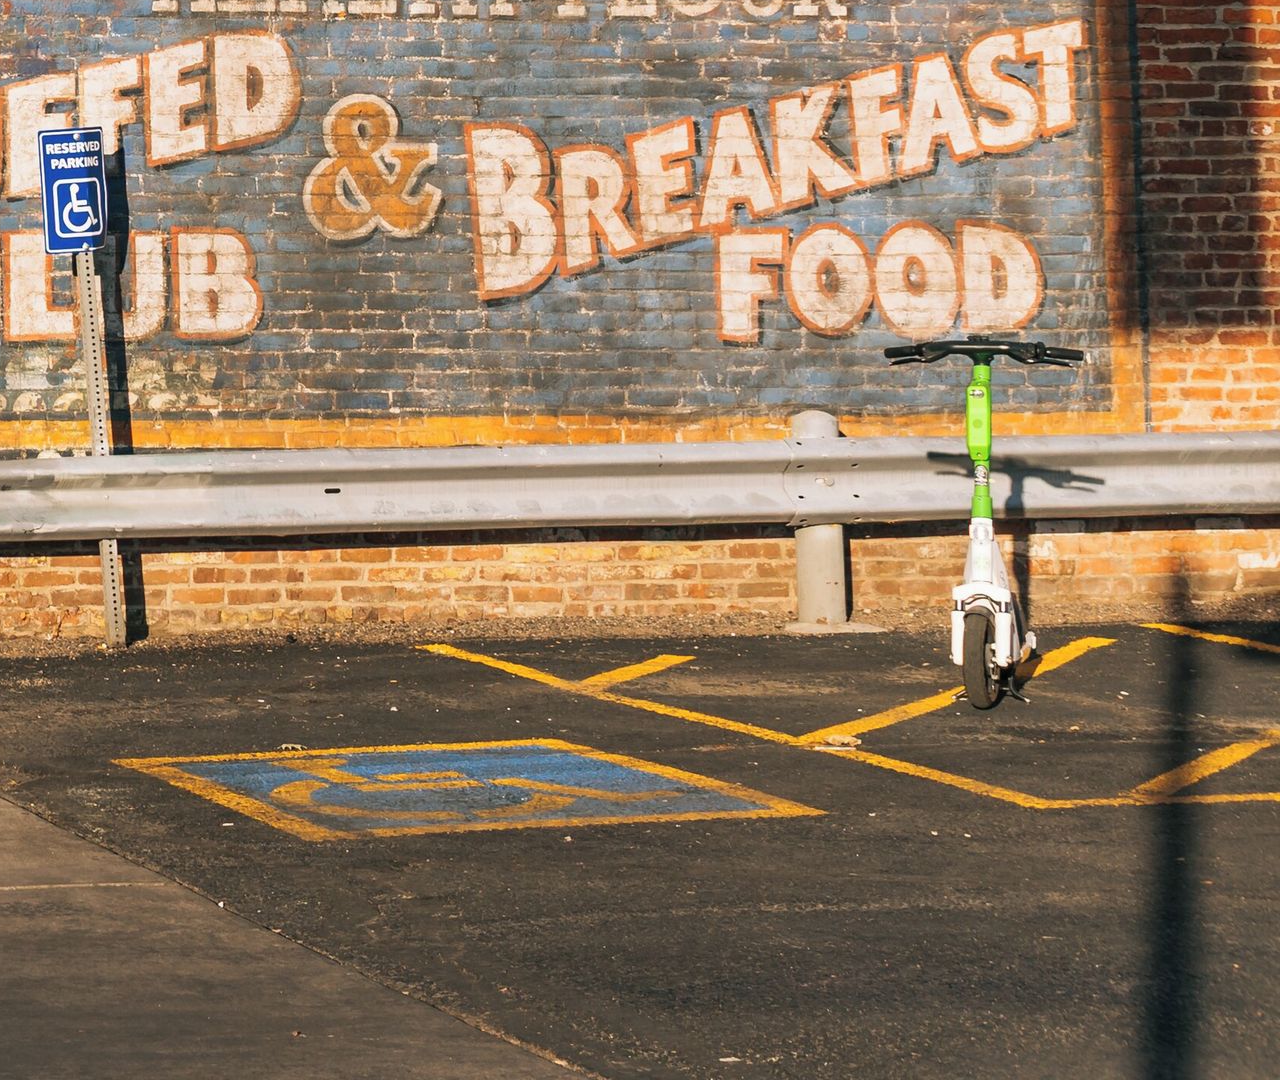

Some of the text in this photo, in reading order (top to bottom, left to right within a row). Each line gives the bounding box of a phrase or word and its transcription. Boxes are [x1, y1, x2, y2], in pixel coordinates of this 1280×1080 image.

[45, 141, 100, 155] RESERVED
[50, 156, 99, 170] PARKING
[303, 93, 443, 241] &
[464, 18, 1089, 302] BREAKFAST
[713, 219, 1048, 344] FOOD
